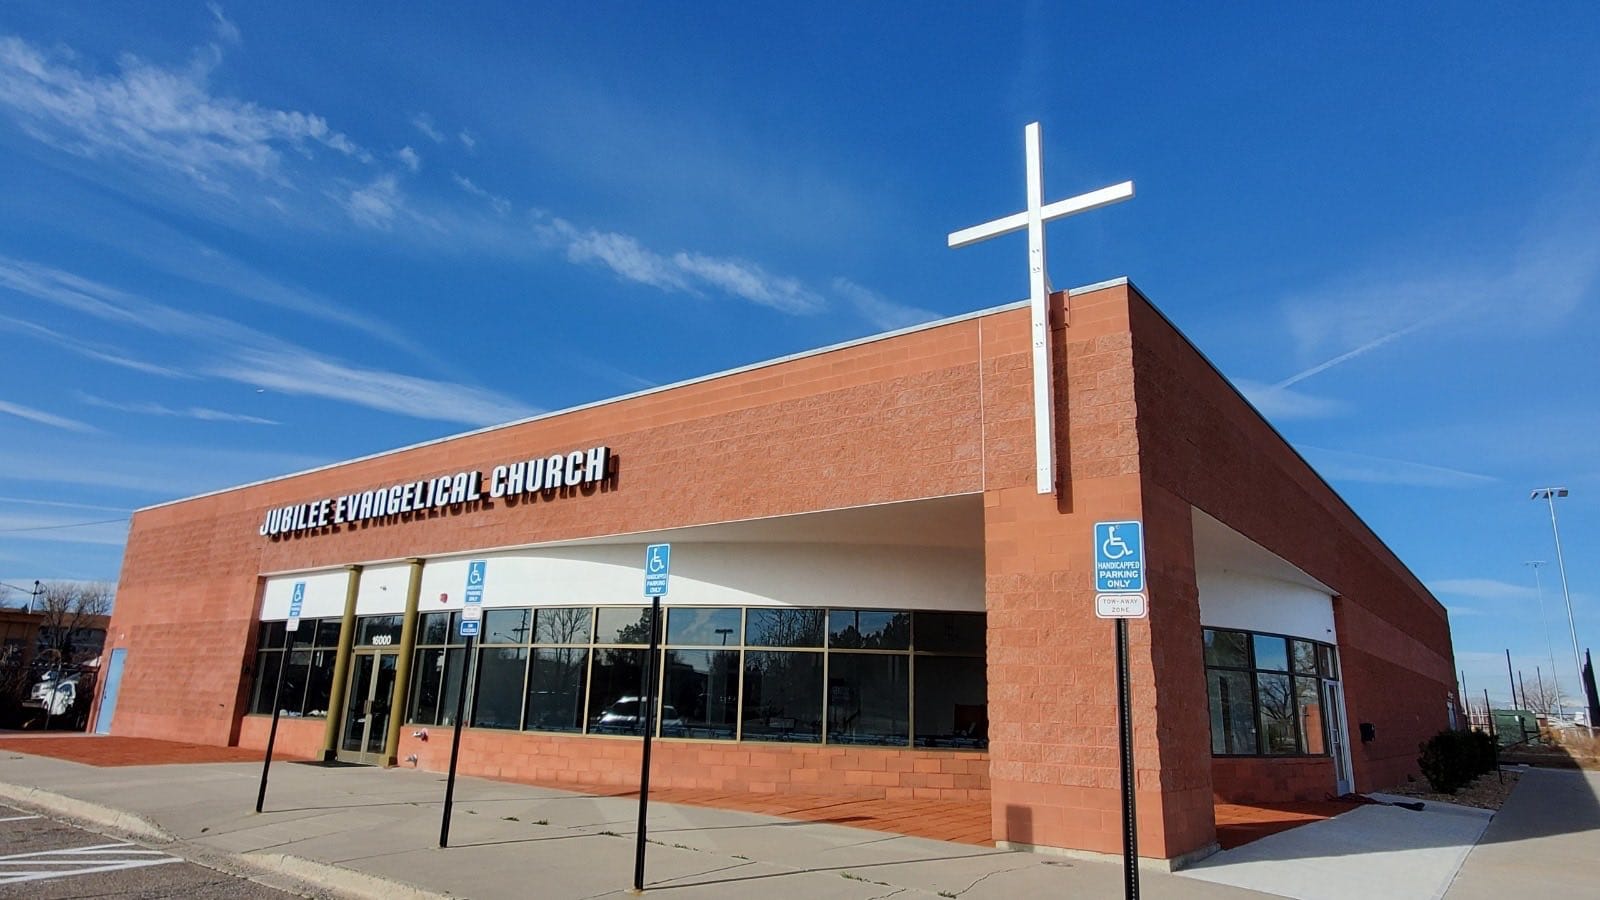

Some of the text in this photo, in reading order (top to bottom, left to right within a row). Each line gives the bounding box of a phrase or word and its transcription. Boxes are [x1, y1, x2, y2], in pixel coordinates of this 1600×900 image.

[259, 446, 607, 537] JUBILEE EVANGELICAL CHURCH
[1098, 561, 1140, 569] HANDICAPPED
[1099, 570, 1139, 578] PARKING
[1107, 580, 1131, 588] ONLY
[372, 635, 392, 646] 16000
